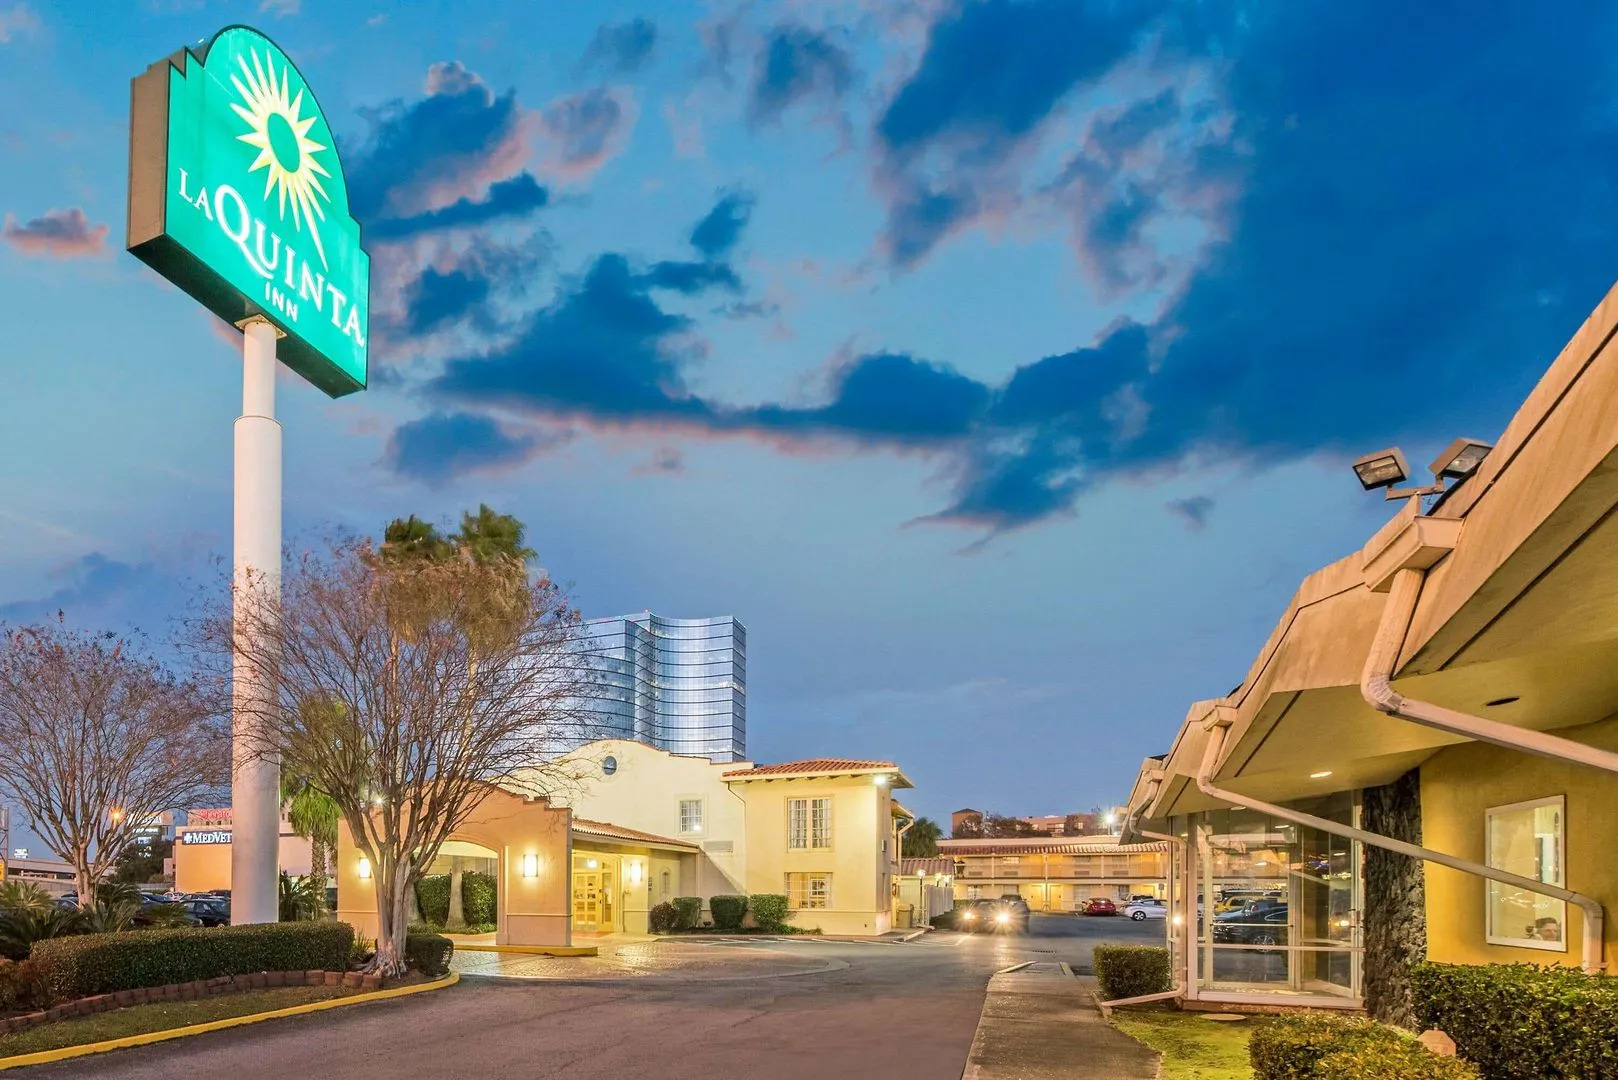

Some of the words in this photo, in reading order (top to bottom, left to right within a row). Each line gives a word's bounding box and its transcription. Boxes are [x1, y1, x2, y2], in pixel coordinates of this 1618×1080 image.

[179, 168, 213, 220] LA
[214, 184, 365, 348] QUINTA
[265, 282, 298, 323] INN
